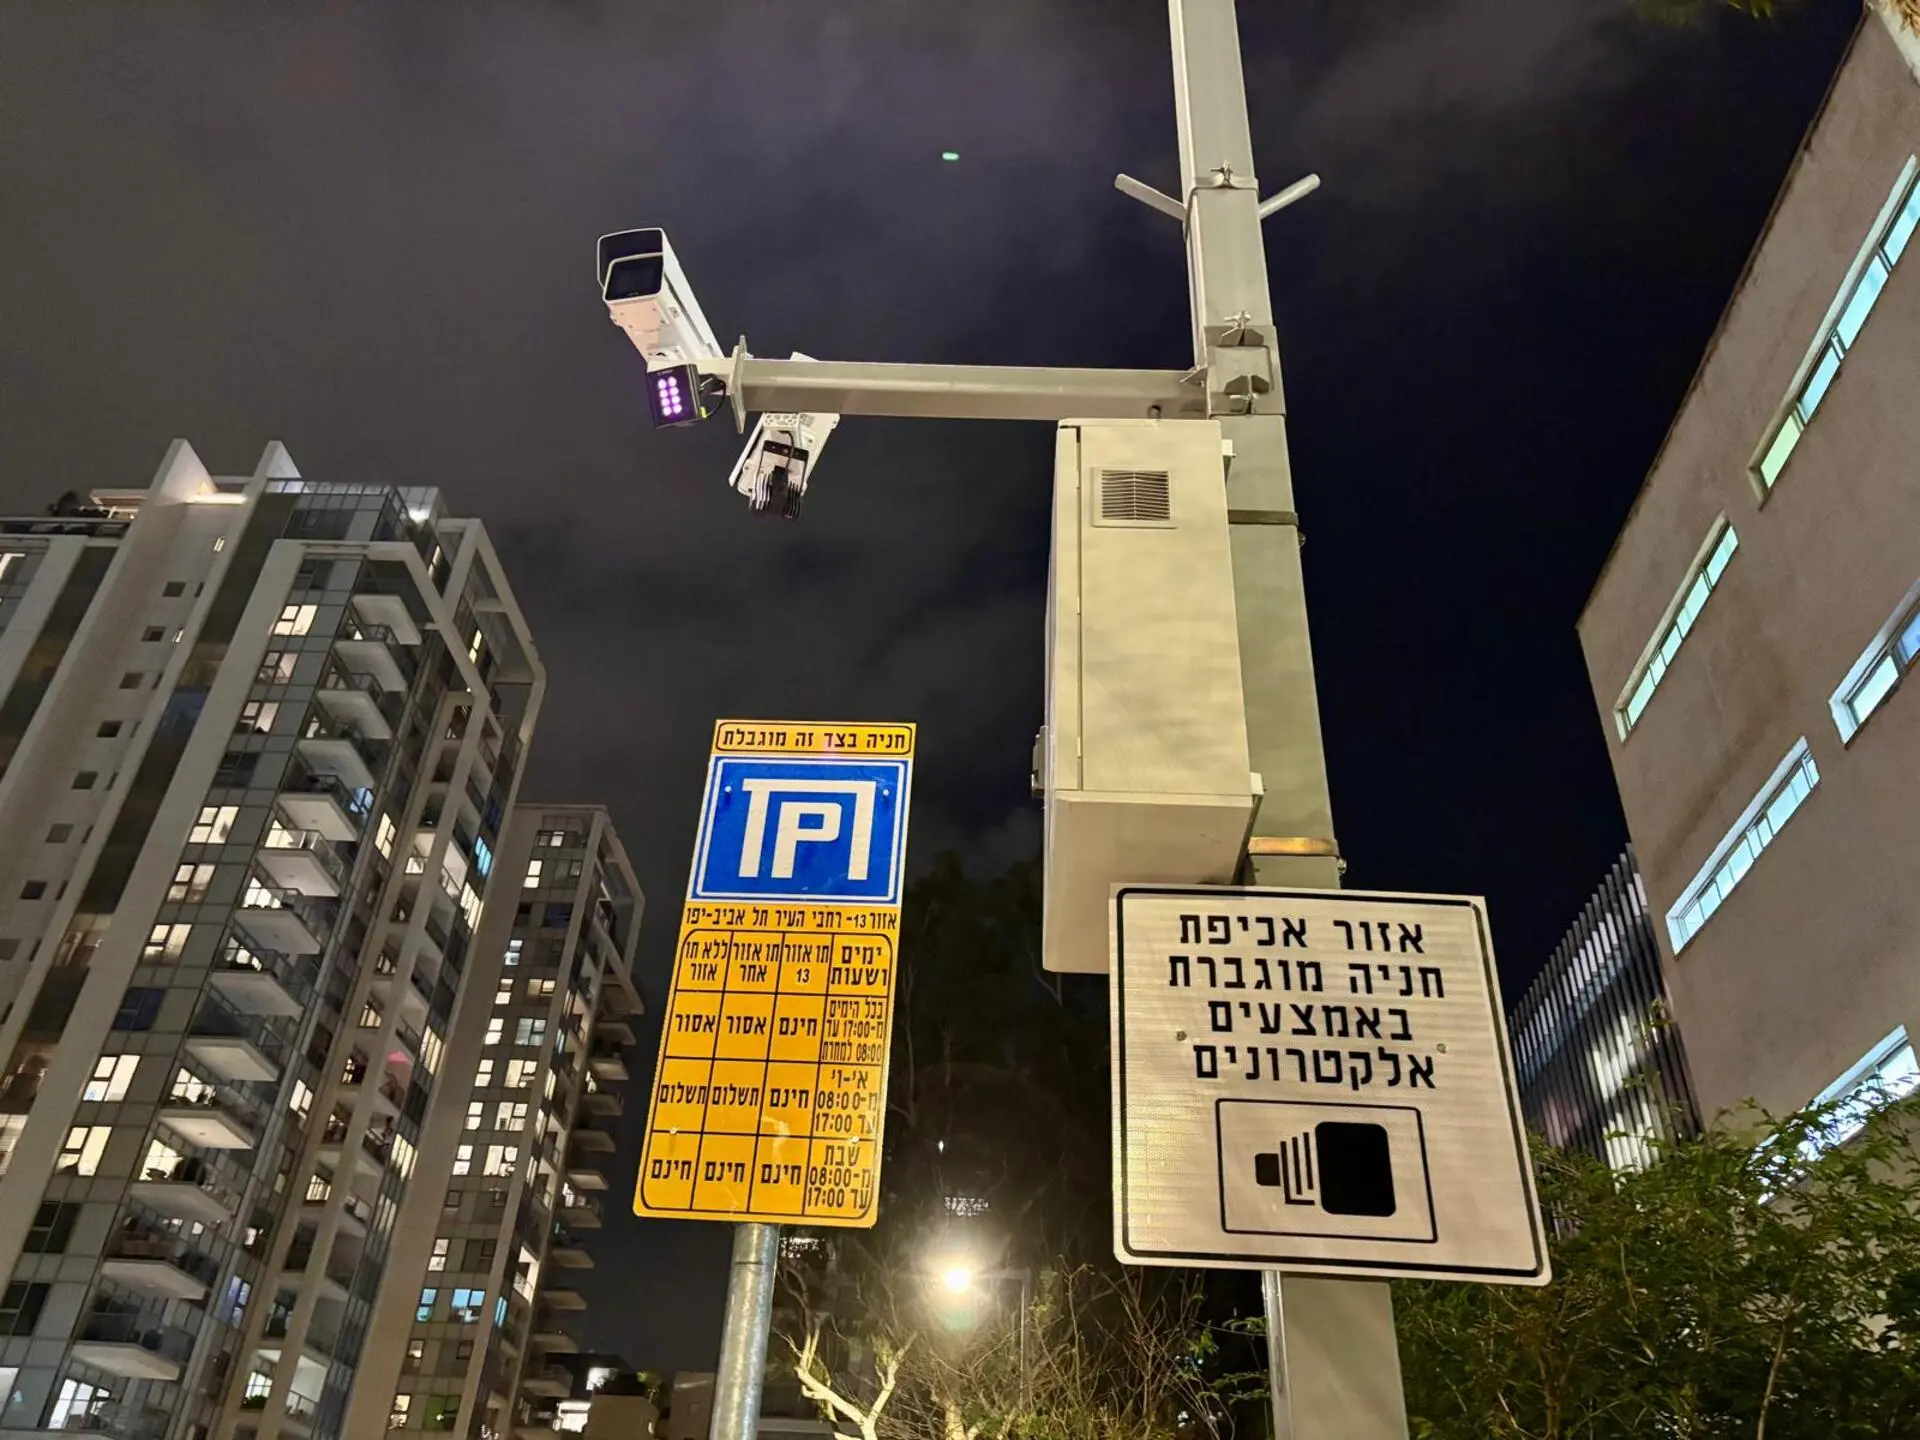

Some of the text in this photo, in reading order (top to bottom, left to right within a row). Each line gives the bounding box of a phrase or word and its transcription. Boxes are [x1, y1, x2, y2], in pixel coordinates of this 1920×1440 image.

[723, 729, 905, 749] חניה בצד זה מוגבלת
[686, 907, 745, 926] אביב-יפו
[752, 906, 768, 926] תל
[776, 910, 805, 927] העיר
[812, 911, 842, 928] רחבי
[871, 913, 897, 930] אזור
[1179, 913, 1425, 954] אזור אכיפת
[685, 939, 728, 960] ללא תו
[733, 942, 780, 962] תו אזור
[784, 943, 829, 963] תו אזור
[841, 946, 882, 964] ימים
[690, 963, 718, 981] אזור
[740, 964, 767, 982] אחר
[796, 968, 810, 983] 13
[830, 967, 888, 986] ושעות
[1168, 955, 1445, 999] חניה מוגברת
[830, 998, 883, 1019] בכל הימים
[675, 1014, 716, 1034] אסור
[726, 1015, 767, 1035] אסור
[779, 1016, 817, 1037] חינם
[826, 1019, 839, 1037] עד
[1208, 1001, 1413, 1041] באמצעים
[822, 1039, 881, 1062] 08:00 למחרת
[1193, 1045, 1436, 1091] אלקטרונים
[659, 1081, 708, 1105] תשלום
[712, 1082, 760, 1107] תשלום
[769, 1088, 810, 1108] חינם
[815, 1113, 876, 1134] עד 17:00
[824, 1145, 860, 1166] שבת
[651, 1159, 692, 1180] חינם
[704, 1160, 746, 1183] חינם
[760, 1163, 802, 1185] חינם
[807, 1187, 869, 1209] עד 17:00
